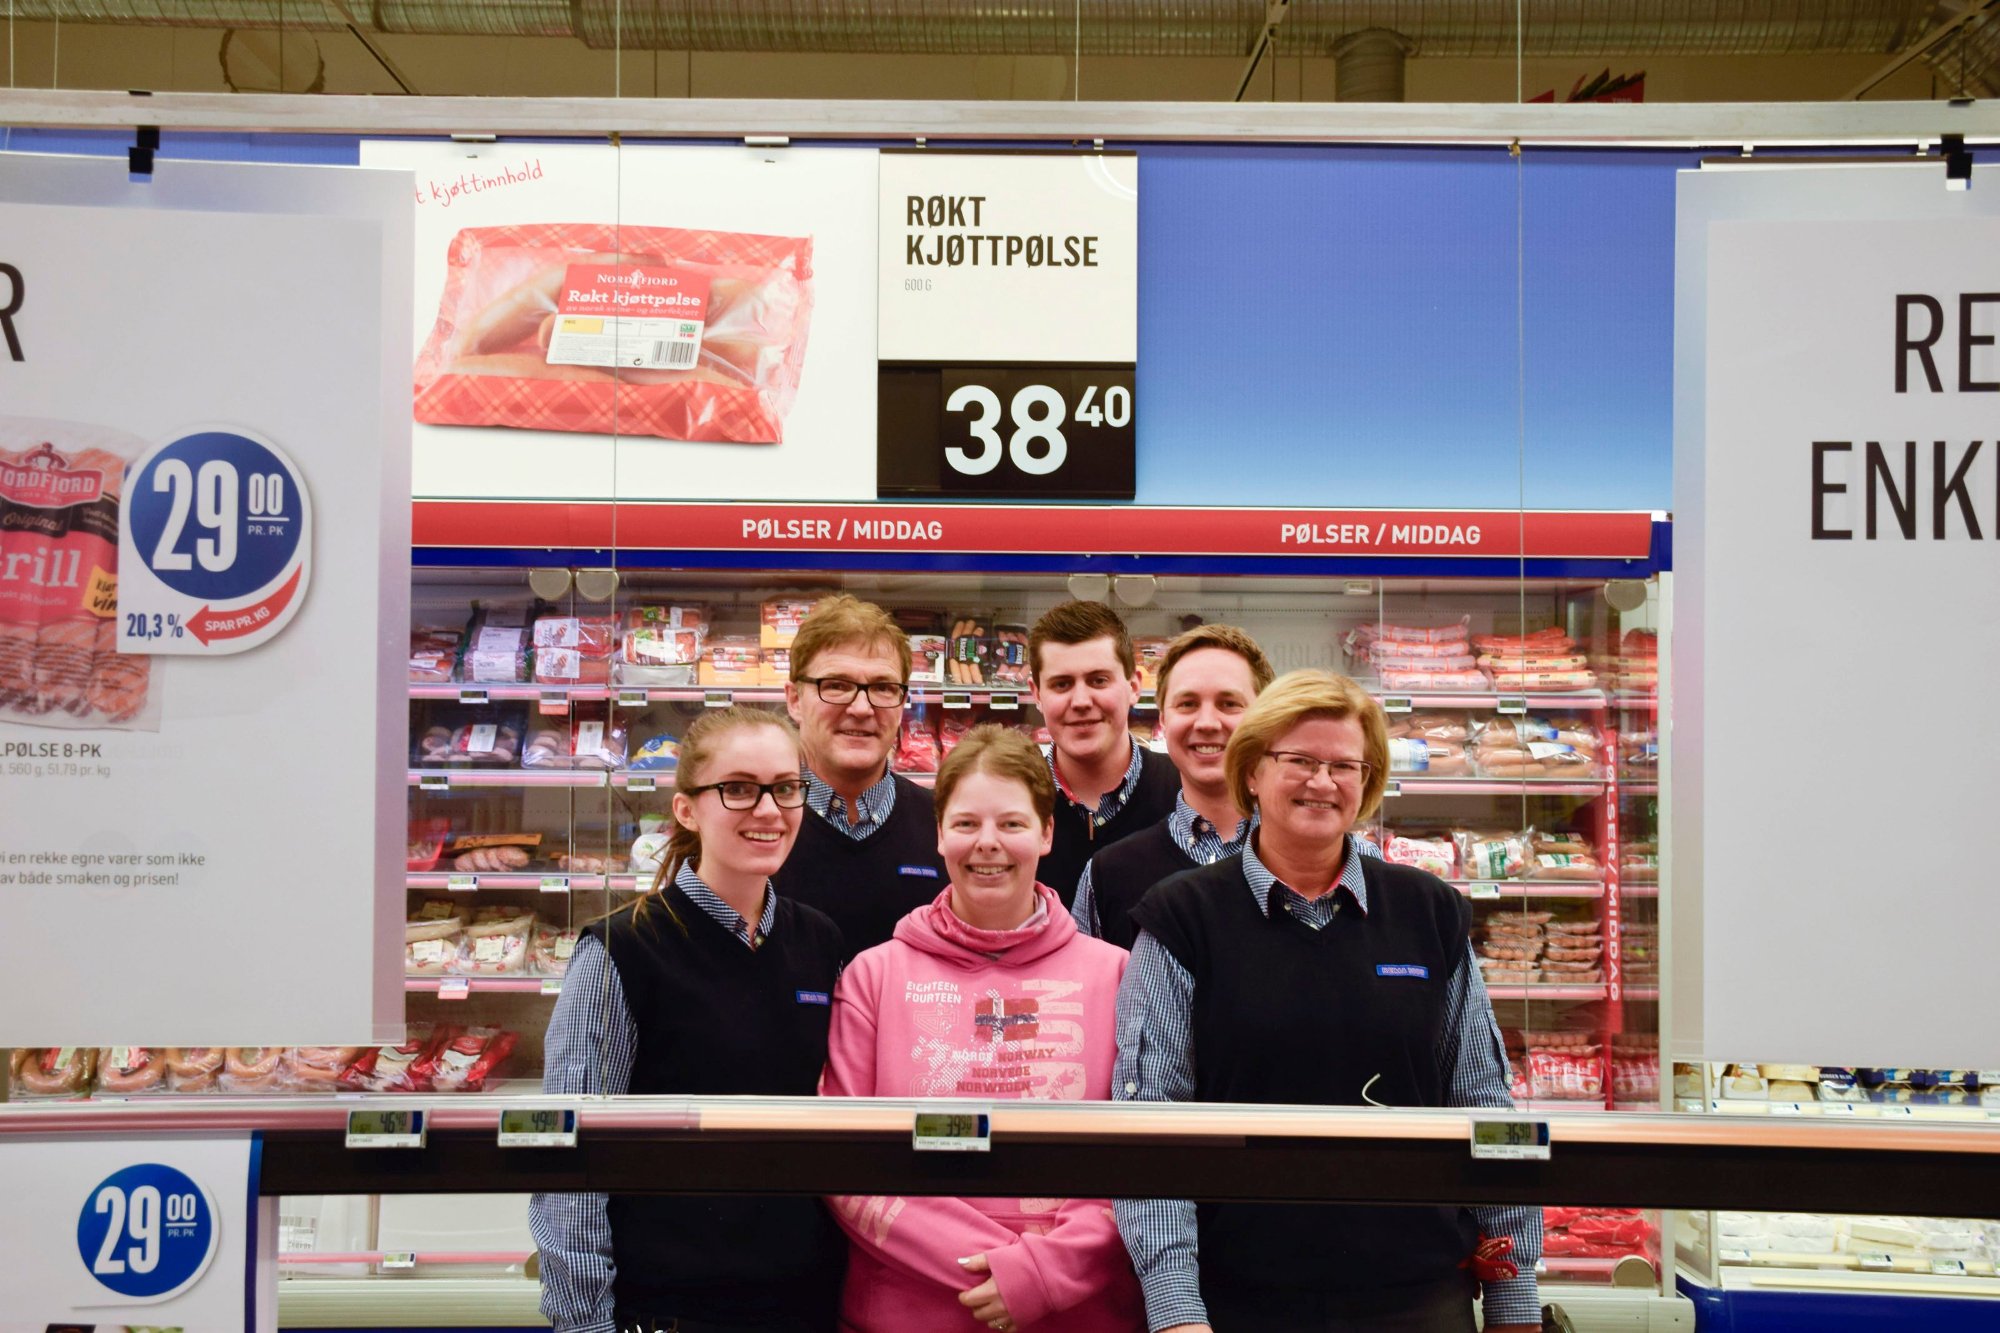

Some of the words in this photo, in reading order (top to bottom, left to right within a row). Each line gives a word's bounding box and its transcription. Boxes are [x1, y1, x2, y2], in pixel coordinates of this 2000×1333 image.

[430, 158, 543, 207] kjøttinnhold
[906, 194, 986, 229] RØKT
[906, 233, 1099, 268] KJØTTPØLSE
[904, 277, 921, 292] 600
[924, 278, 932, 292] G
[568, 289, 609, 303] Røkt
[613, 289, 701, 308] kjøttpølse
[944, 385, 1068, 475] 38
[1075, 385, 1131, 428] 40
[0, 467, 96, 494] ORDFJORD
[1811, 441, 2000, 540] ENK
[152, 458, 239, 572] 29
[249, 473, 284, 516] 00
[248, 525, 266, 536] PR.
[269, 526, 284, 536] PK
[742, 518, 831, 539] PØLSER
[837, 518, 848, 541] /
[854, 520, 942, 540] MIDDAG
[1281, 523, 1369, 544] PØLSER
[1375, 523, 1386, 545] /
[1392, 525, 1480, 544] MIDDAG
[0, 545, 81, 588] rill
[126, 613, 163, 640] 20,3
[167, 613, 183, 638] %
[205, 615, 237, 632] SPAR
[236, 612, 253, 627] PR.
[254, 606, 271, 622] KG
[0, 743, 59, 757] PØLSE
[63, 743, 102, 758] 8-PK
[9, 763, 32, 775] 560
[97, 764, 111, 778] kg
[9, 854, 26, 865] en
[30, 851, 68, 865] rekke
[71, 854, 105, 867] egne
[108, 854, 142, 865] varer
[146, 855, 174, 865] som
[178, 852, 205, 866] ikke
[19, 871, 52, 885] både
[56, 872, 110, 885] smaken
[114, 875, 130, 887] og
[133, 873, 179, 887] prisen!
[1608, 883, 1620, 1001] MIDDAG
[905, 992, 961, 1004] FOURTEEN
[906, 981, 958, 993] EIGHTEEN
[998, 1048, 1055, 1063] NORWAY
[94, 1185, 161, 1274] 29
[167, 1193, 196, 1221] 00
[168, 1228, 182, 1238] PR.
[183, 1228, 195, 1238] PK
